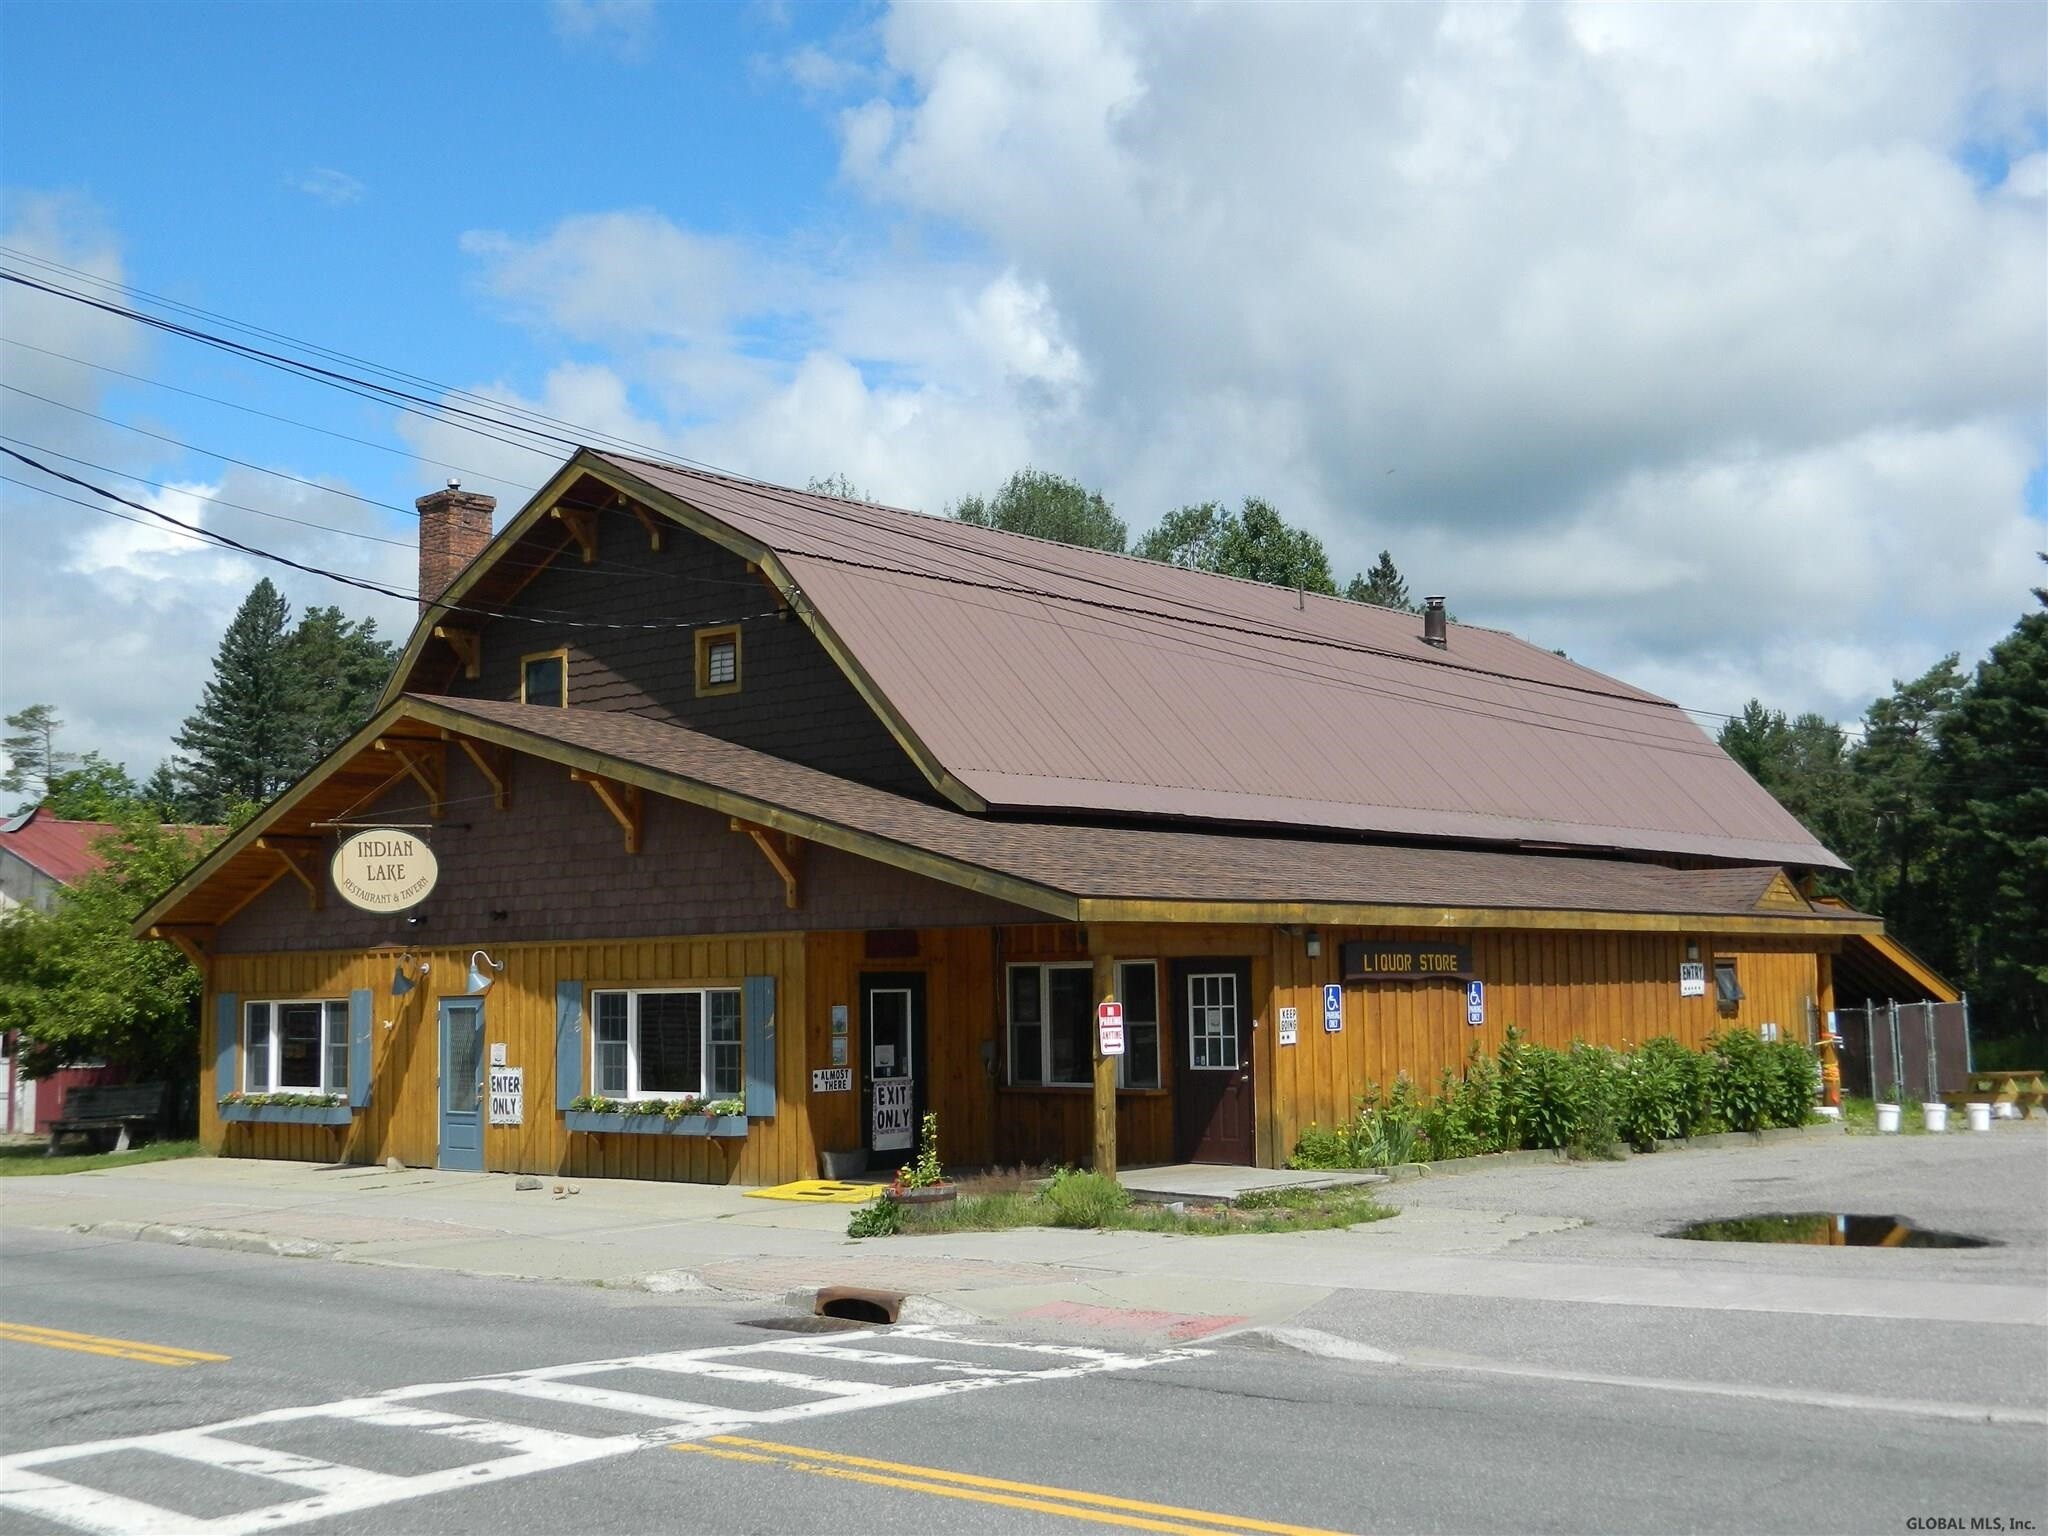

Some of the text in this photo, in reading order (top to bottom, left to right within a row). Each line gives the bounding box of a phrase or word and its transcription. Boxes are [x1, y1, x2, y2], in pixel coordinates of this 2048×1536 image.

[358, 840, 414, 858] INDIAN
[367, 864, 406, 882] LAKE
[344, 876, 429, 904] RESTAURANT & TAVERN
[1363, 954, 1458, 972] LIQUOR STORE
[1682, 966, 1703, 980] ENTRY
[1282, 1009, 1296, 1019] KEEP
[1282, 1020, 1296, 1030] GOING
[1102, 1030, 1122, 1040] ANYTIME
[821, 1070, 848, 1080] ALMOST
[491, 1076, 520, 1093] ENTER
[825, 1080, 846, 1090] THERE
[878, 1086, 906, 1105] EXIT
[492, 1097, 517, 1115] ONLY
[877, 1108, 909, 1129] ONLY
